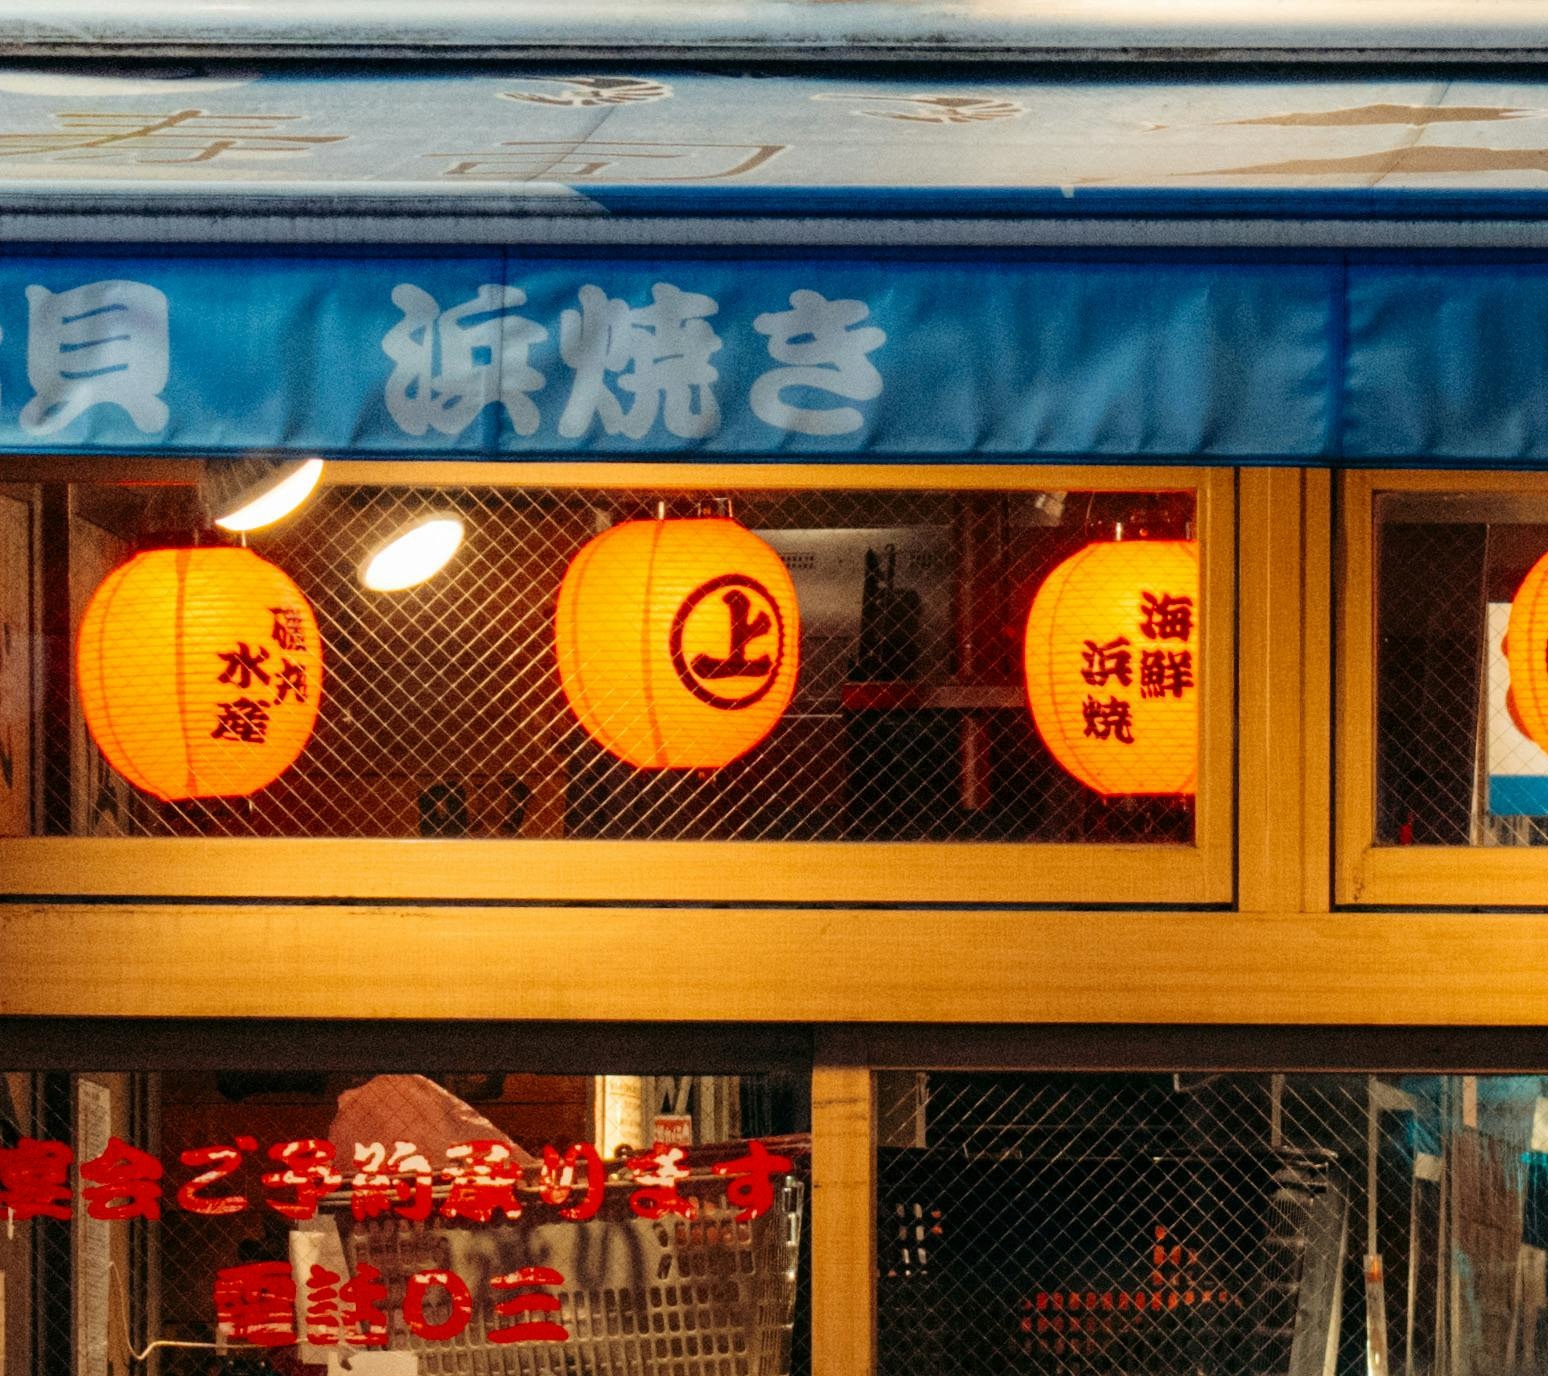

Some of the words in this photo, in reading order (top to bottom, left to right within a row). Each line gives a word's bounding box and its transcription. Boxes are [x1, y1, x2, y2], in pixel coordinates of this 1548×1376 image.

[25, 281, 169, 438] 貝
[381, 281, 890, 440] 浜焼き
[690, 590, 773, 682] 上
[1137, 590, 1195, 700] 海鮮
[212, 640, 272, 747] 水産
[1078, 640, 1136, 747] 浜焼
